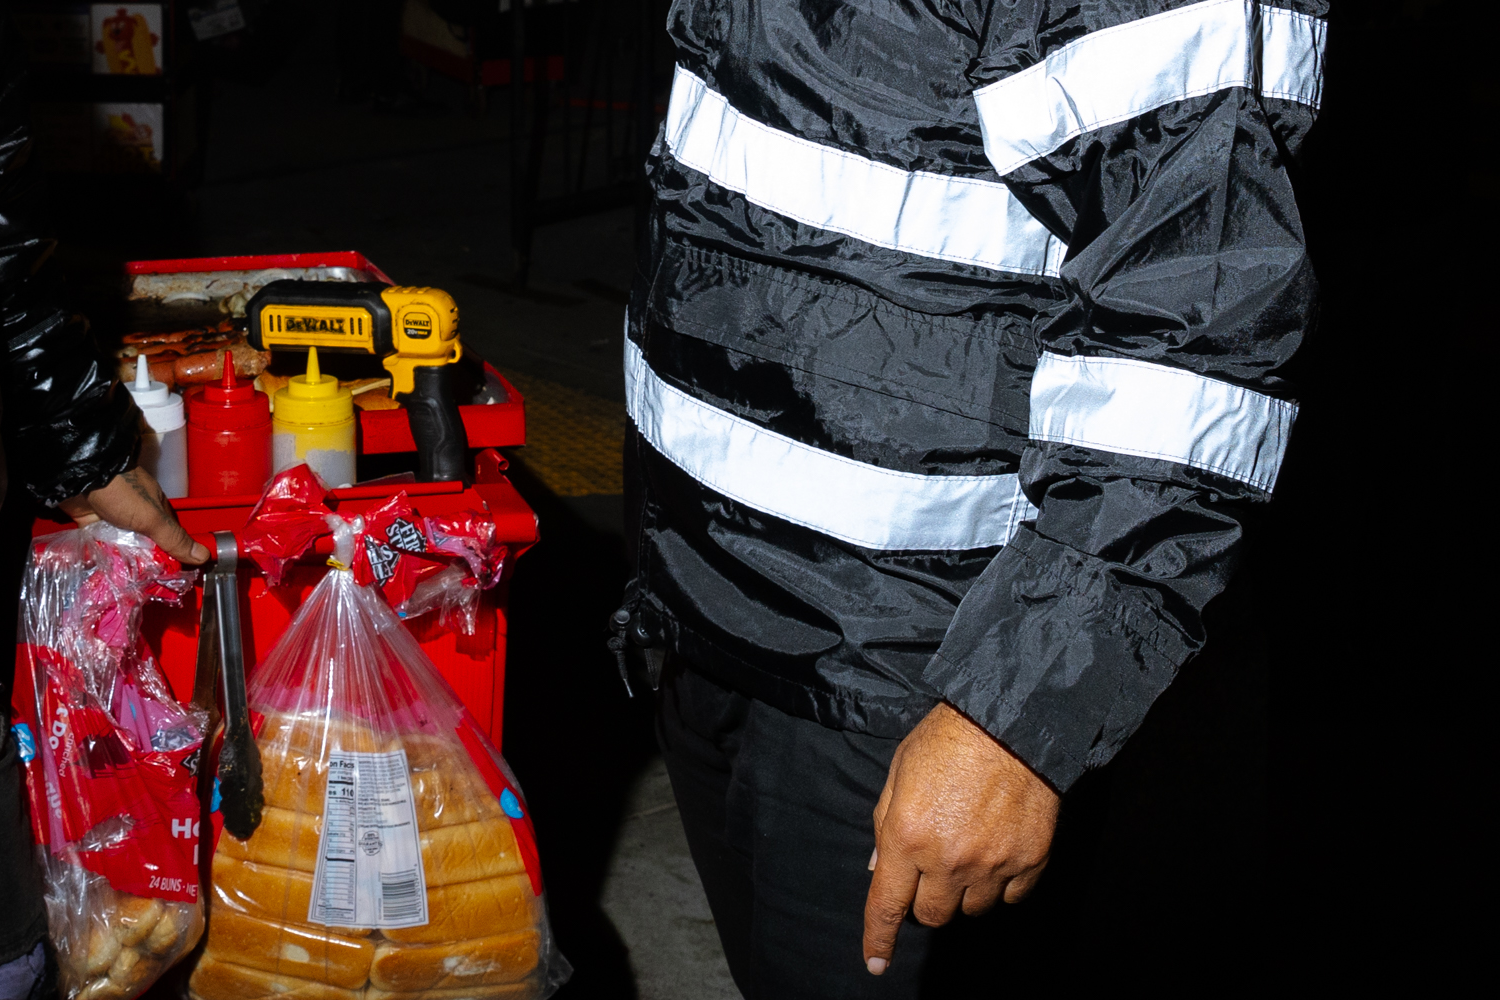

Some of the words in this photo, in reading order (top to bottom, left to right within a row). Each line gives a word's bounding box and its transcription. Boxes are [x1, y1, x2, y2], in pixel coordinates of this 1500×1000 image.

[48, 720, 67, 756] Do
[59, 732, 75, 778] enriched
[149, 875, 161, 889] 24
[160, 877, 182, 893] BUNS
